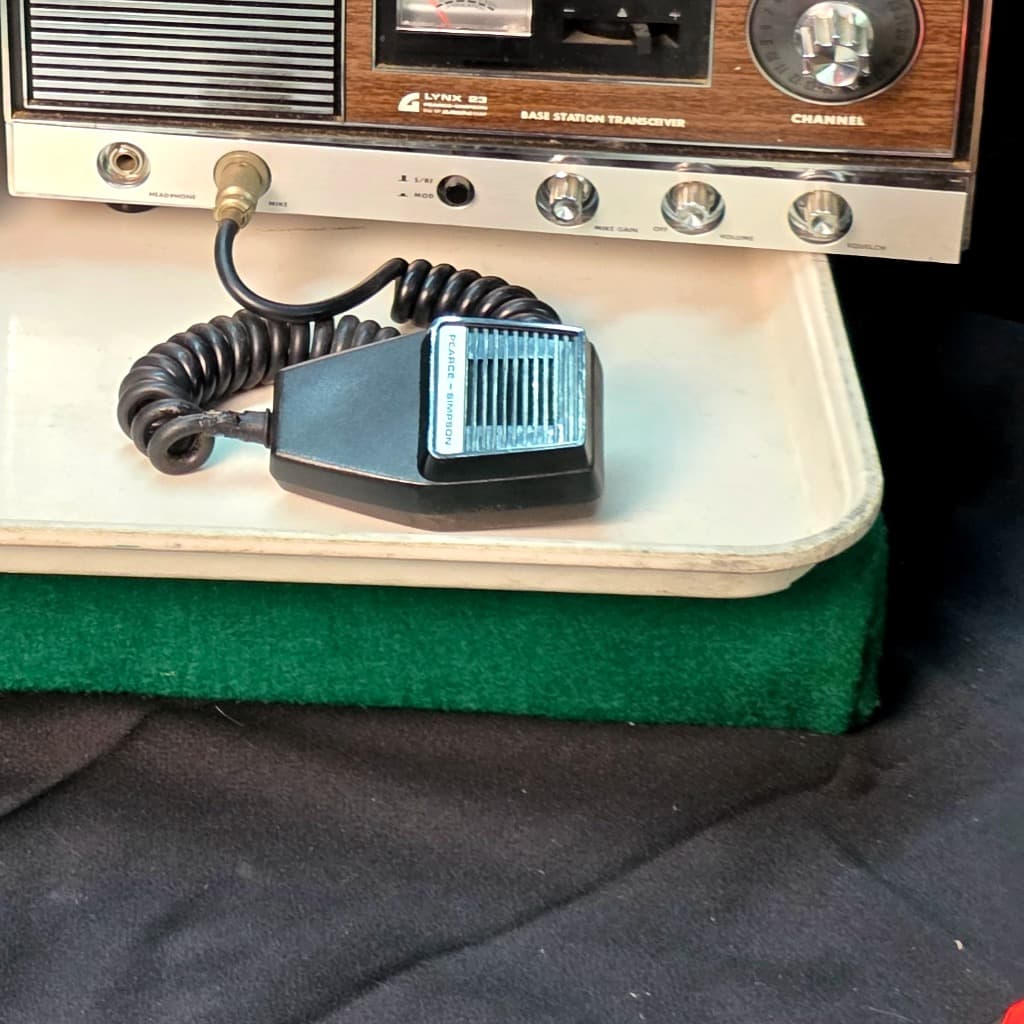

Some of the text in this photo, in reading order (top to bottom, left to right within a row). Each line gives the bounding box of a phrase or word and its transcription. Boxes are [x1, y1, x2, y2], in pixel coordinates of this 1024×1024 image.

[423, 92, 463, 103] LYNX
[520, 110, 686, 128] BASE STATION TRANSCEIVER
[789, 113, 867, 126] CHANNEL
